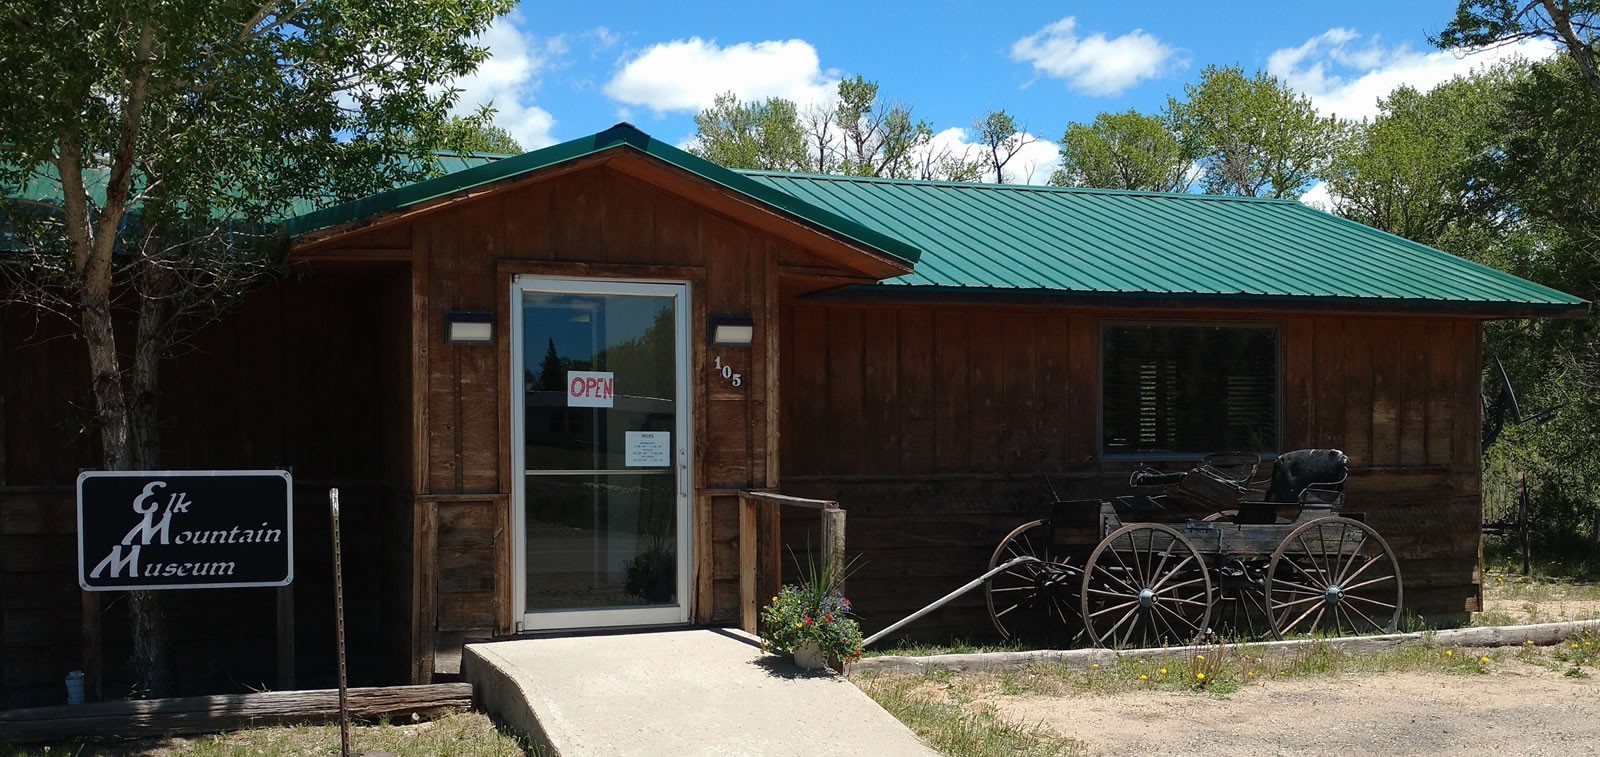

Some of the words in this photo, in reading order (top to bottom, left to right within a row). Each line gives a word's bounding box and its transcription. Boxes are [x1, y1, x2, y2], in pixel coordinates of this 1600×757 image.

[714, 356, 741, 387] 105
[571, 377, 612, 400] OPEN
[133, 481, 192, 514] Elk
[121, 511, 281, 545] Mountain
[90, 545, 235, 578] Museum
